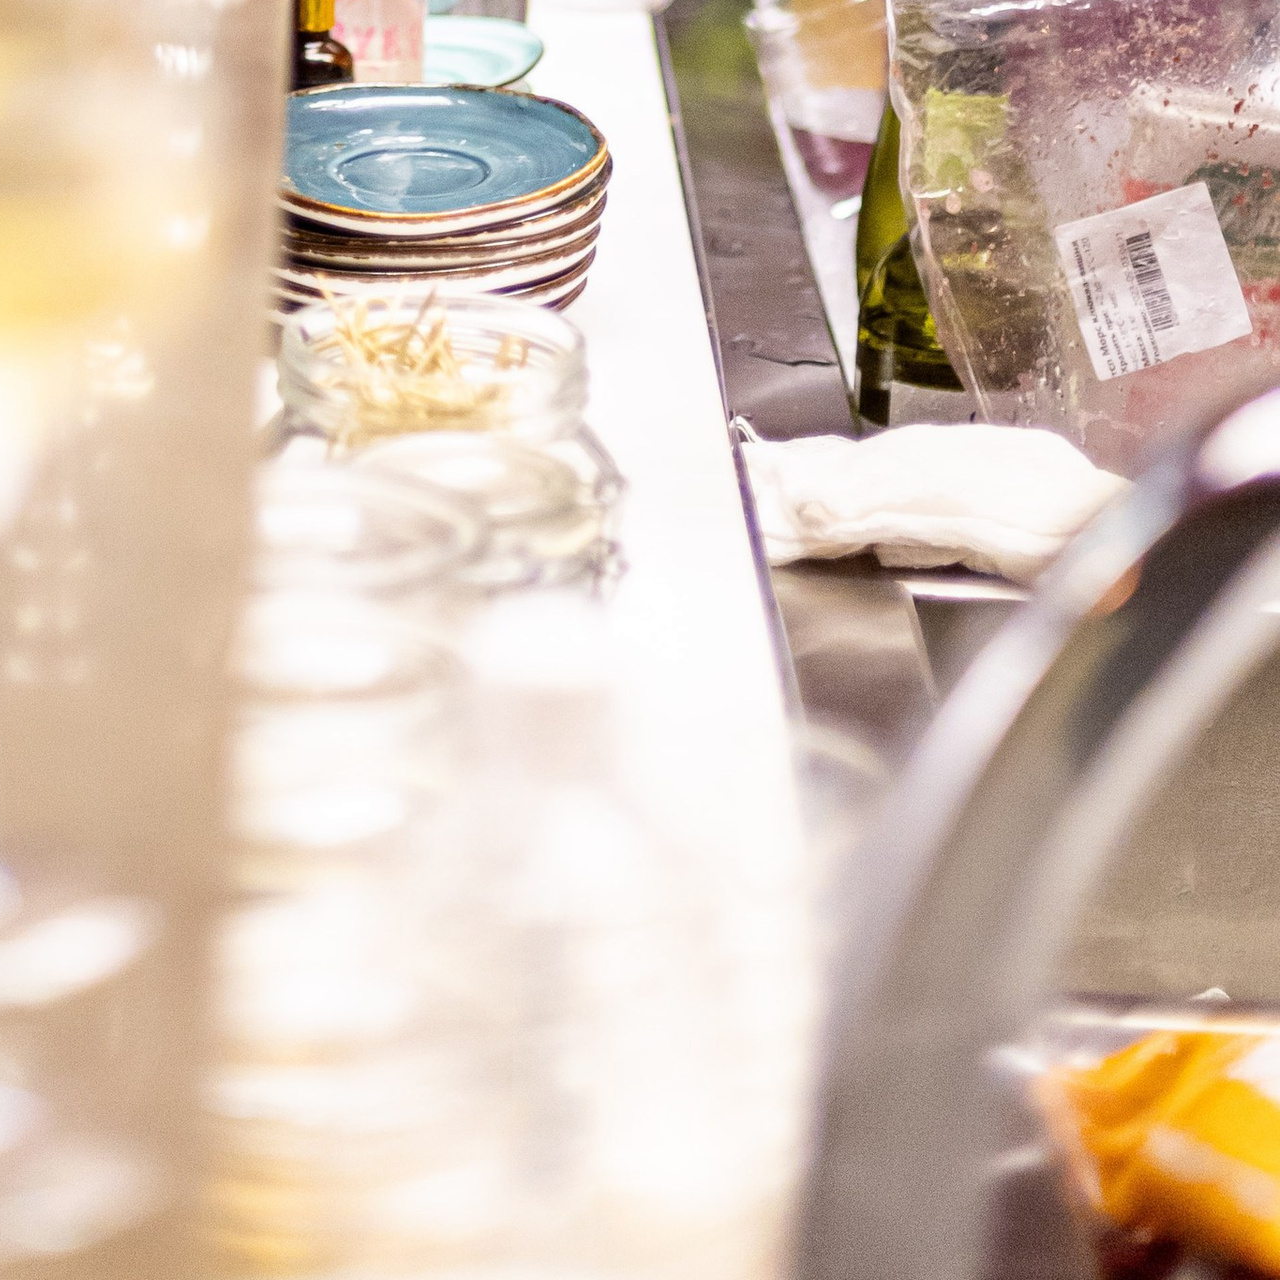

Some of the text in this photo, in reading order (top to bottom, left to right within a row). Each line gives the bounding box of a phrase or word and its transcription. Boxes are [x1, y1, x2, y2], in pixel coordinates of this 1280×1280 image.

[1094, 325, 1111, 356] Морс
[1109, 332, 1129, 373] Хранить
[1134, 333, 1150, 366] Масса:
